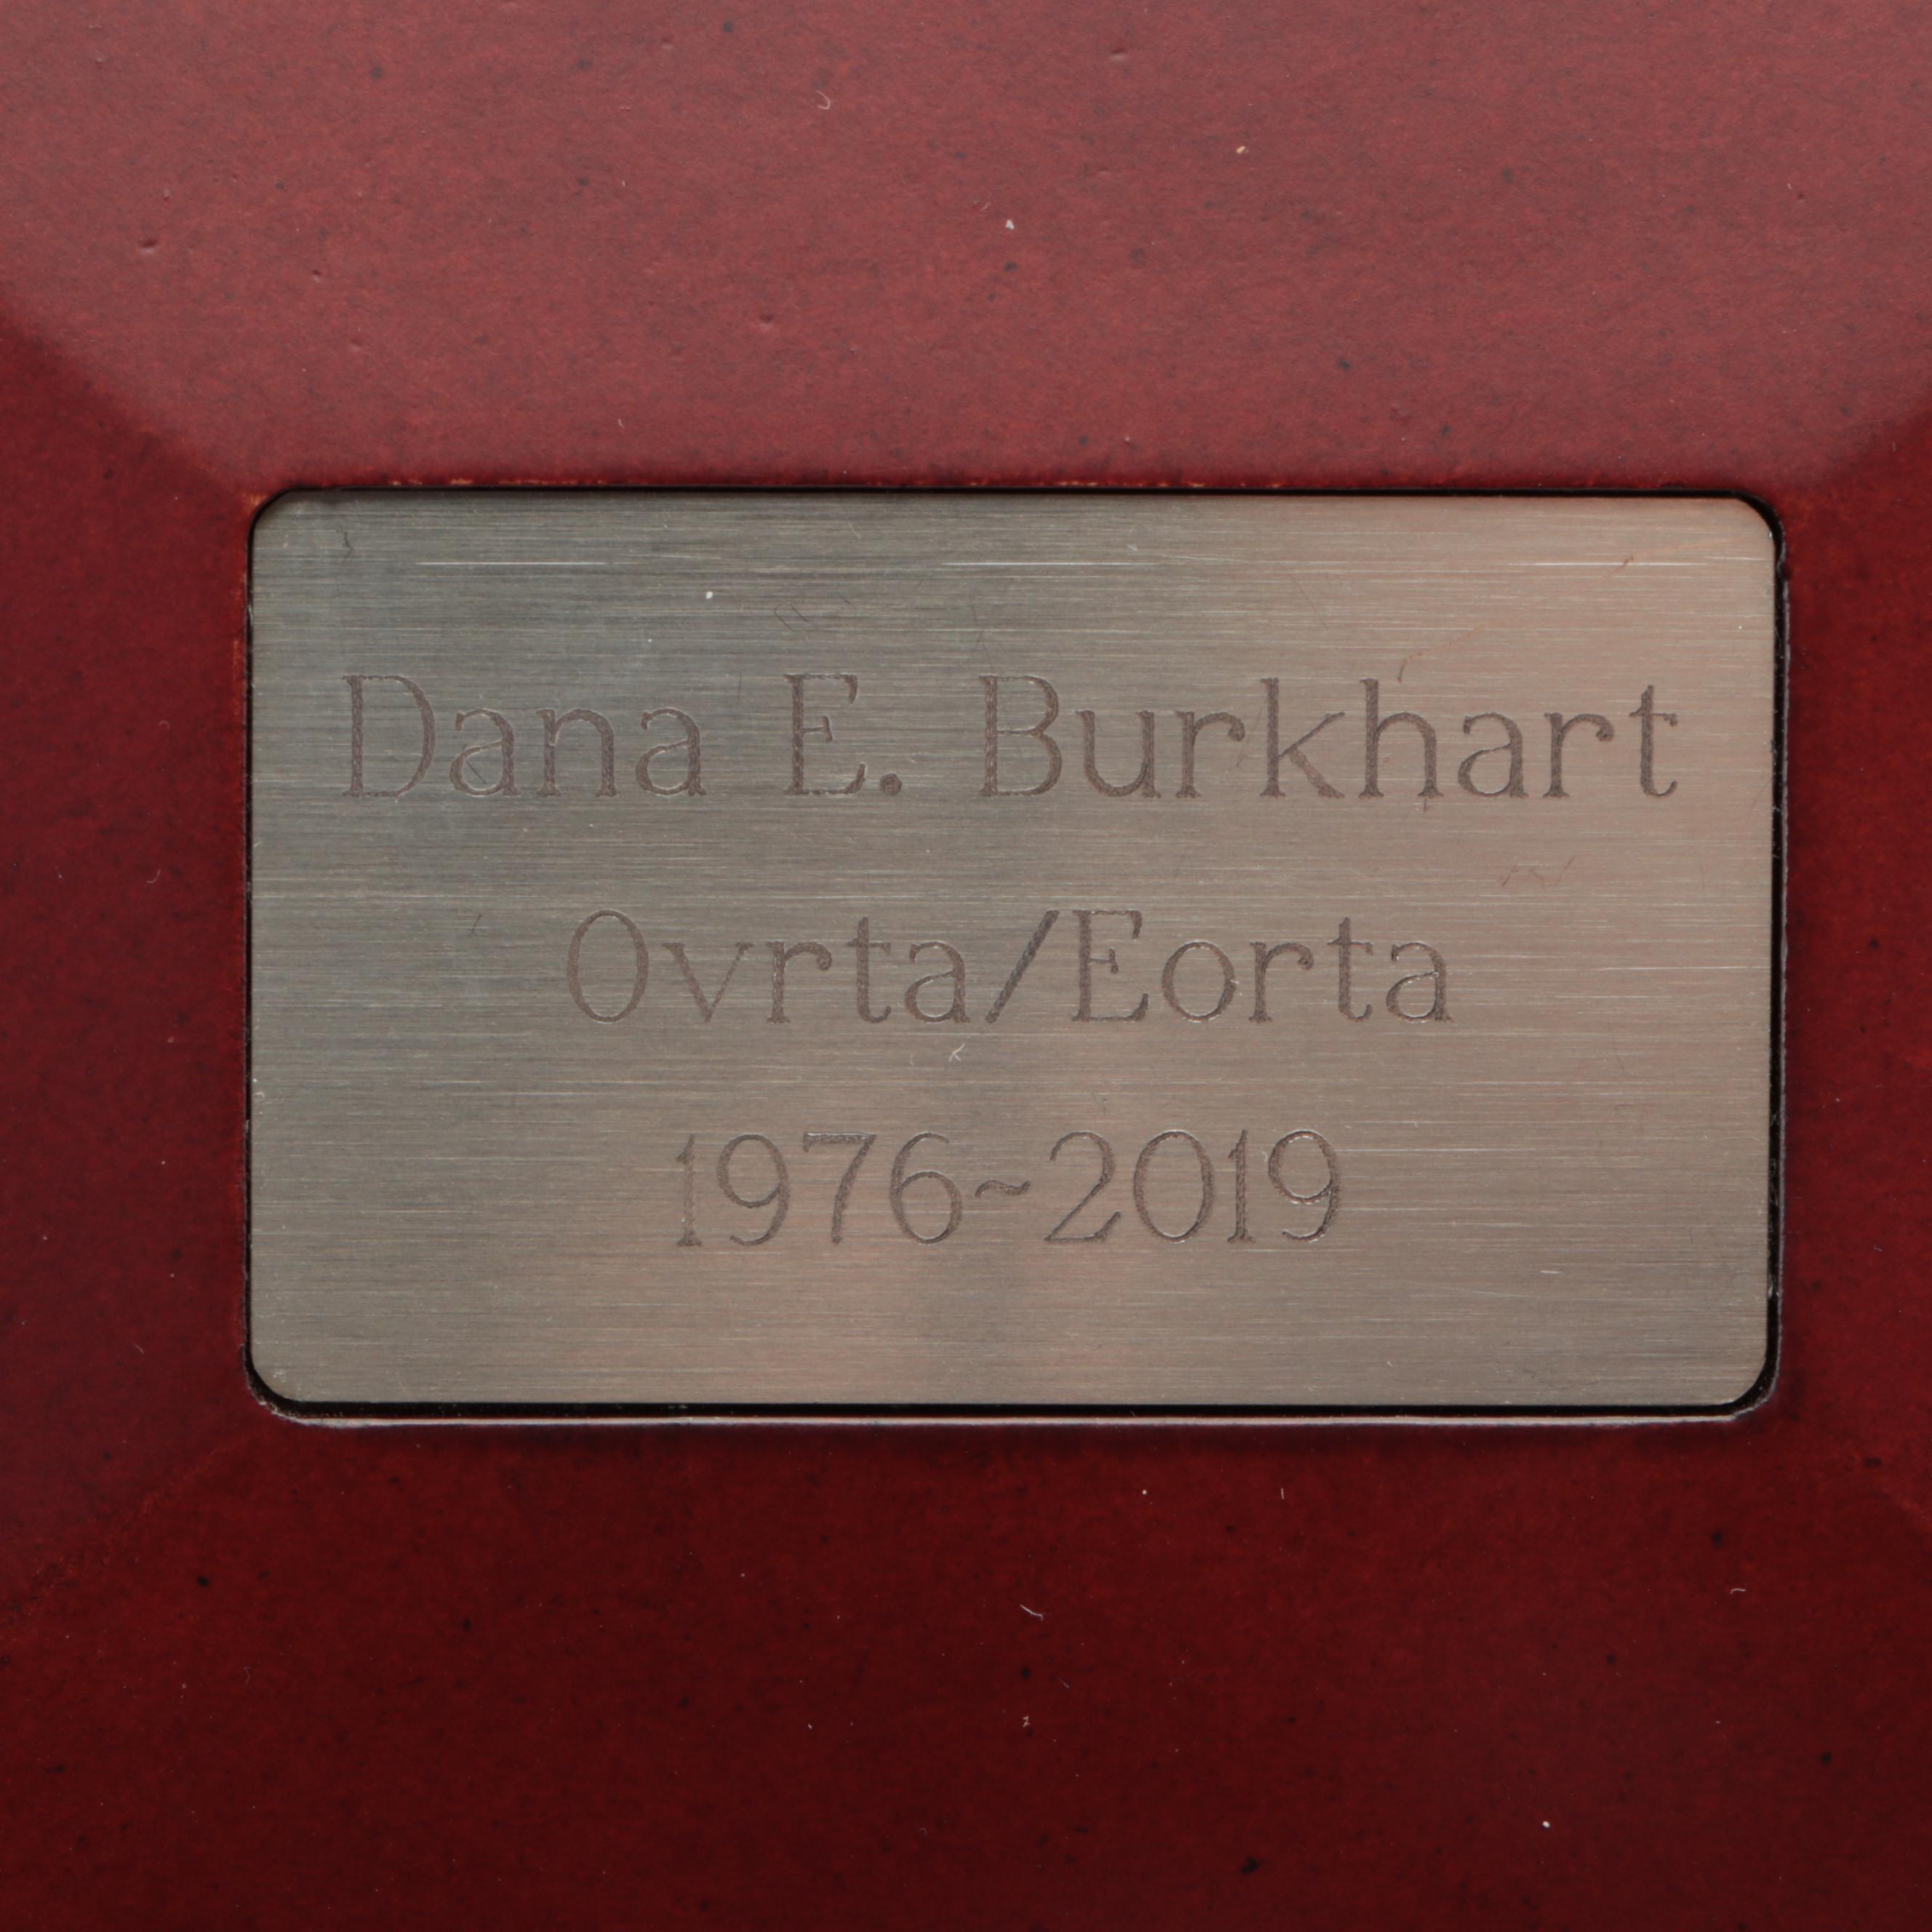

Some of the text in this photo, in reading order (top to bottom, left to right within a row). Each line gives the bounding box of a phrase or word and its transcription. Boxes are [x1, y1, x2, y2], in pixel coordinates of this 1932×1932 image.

[341, 673, 1679, 799] Dana E. Burkhart
[566, 909, 1453, 1023] Ovrta/Eorta
[676, 1129, 1342, 1248] 1976~2019
